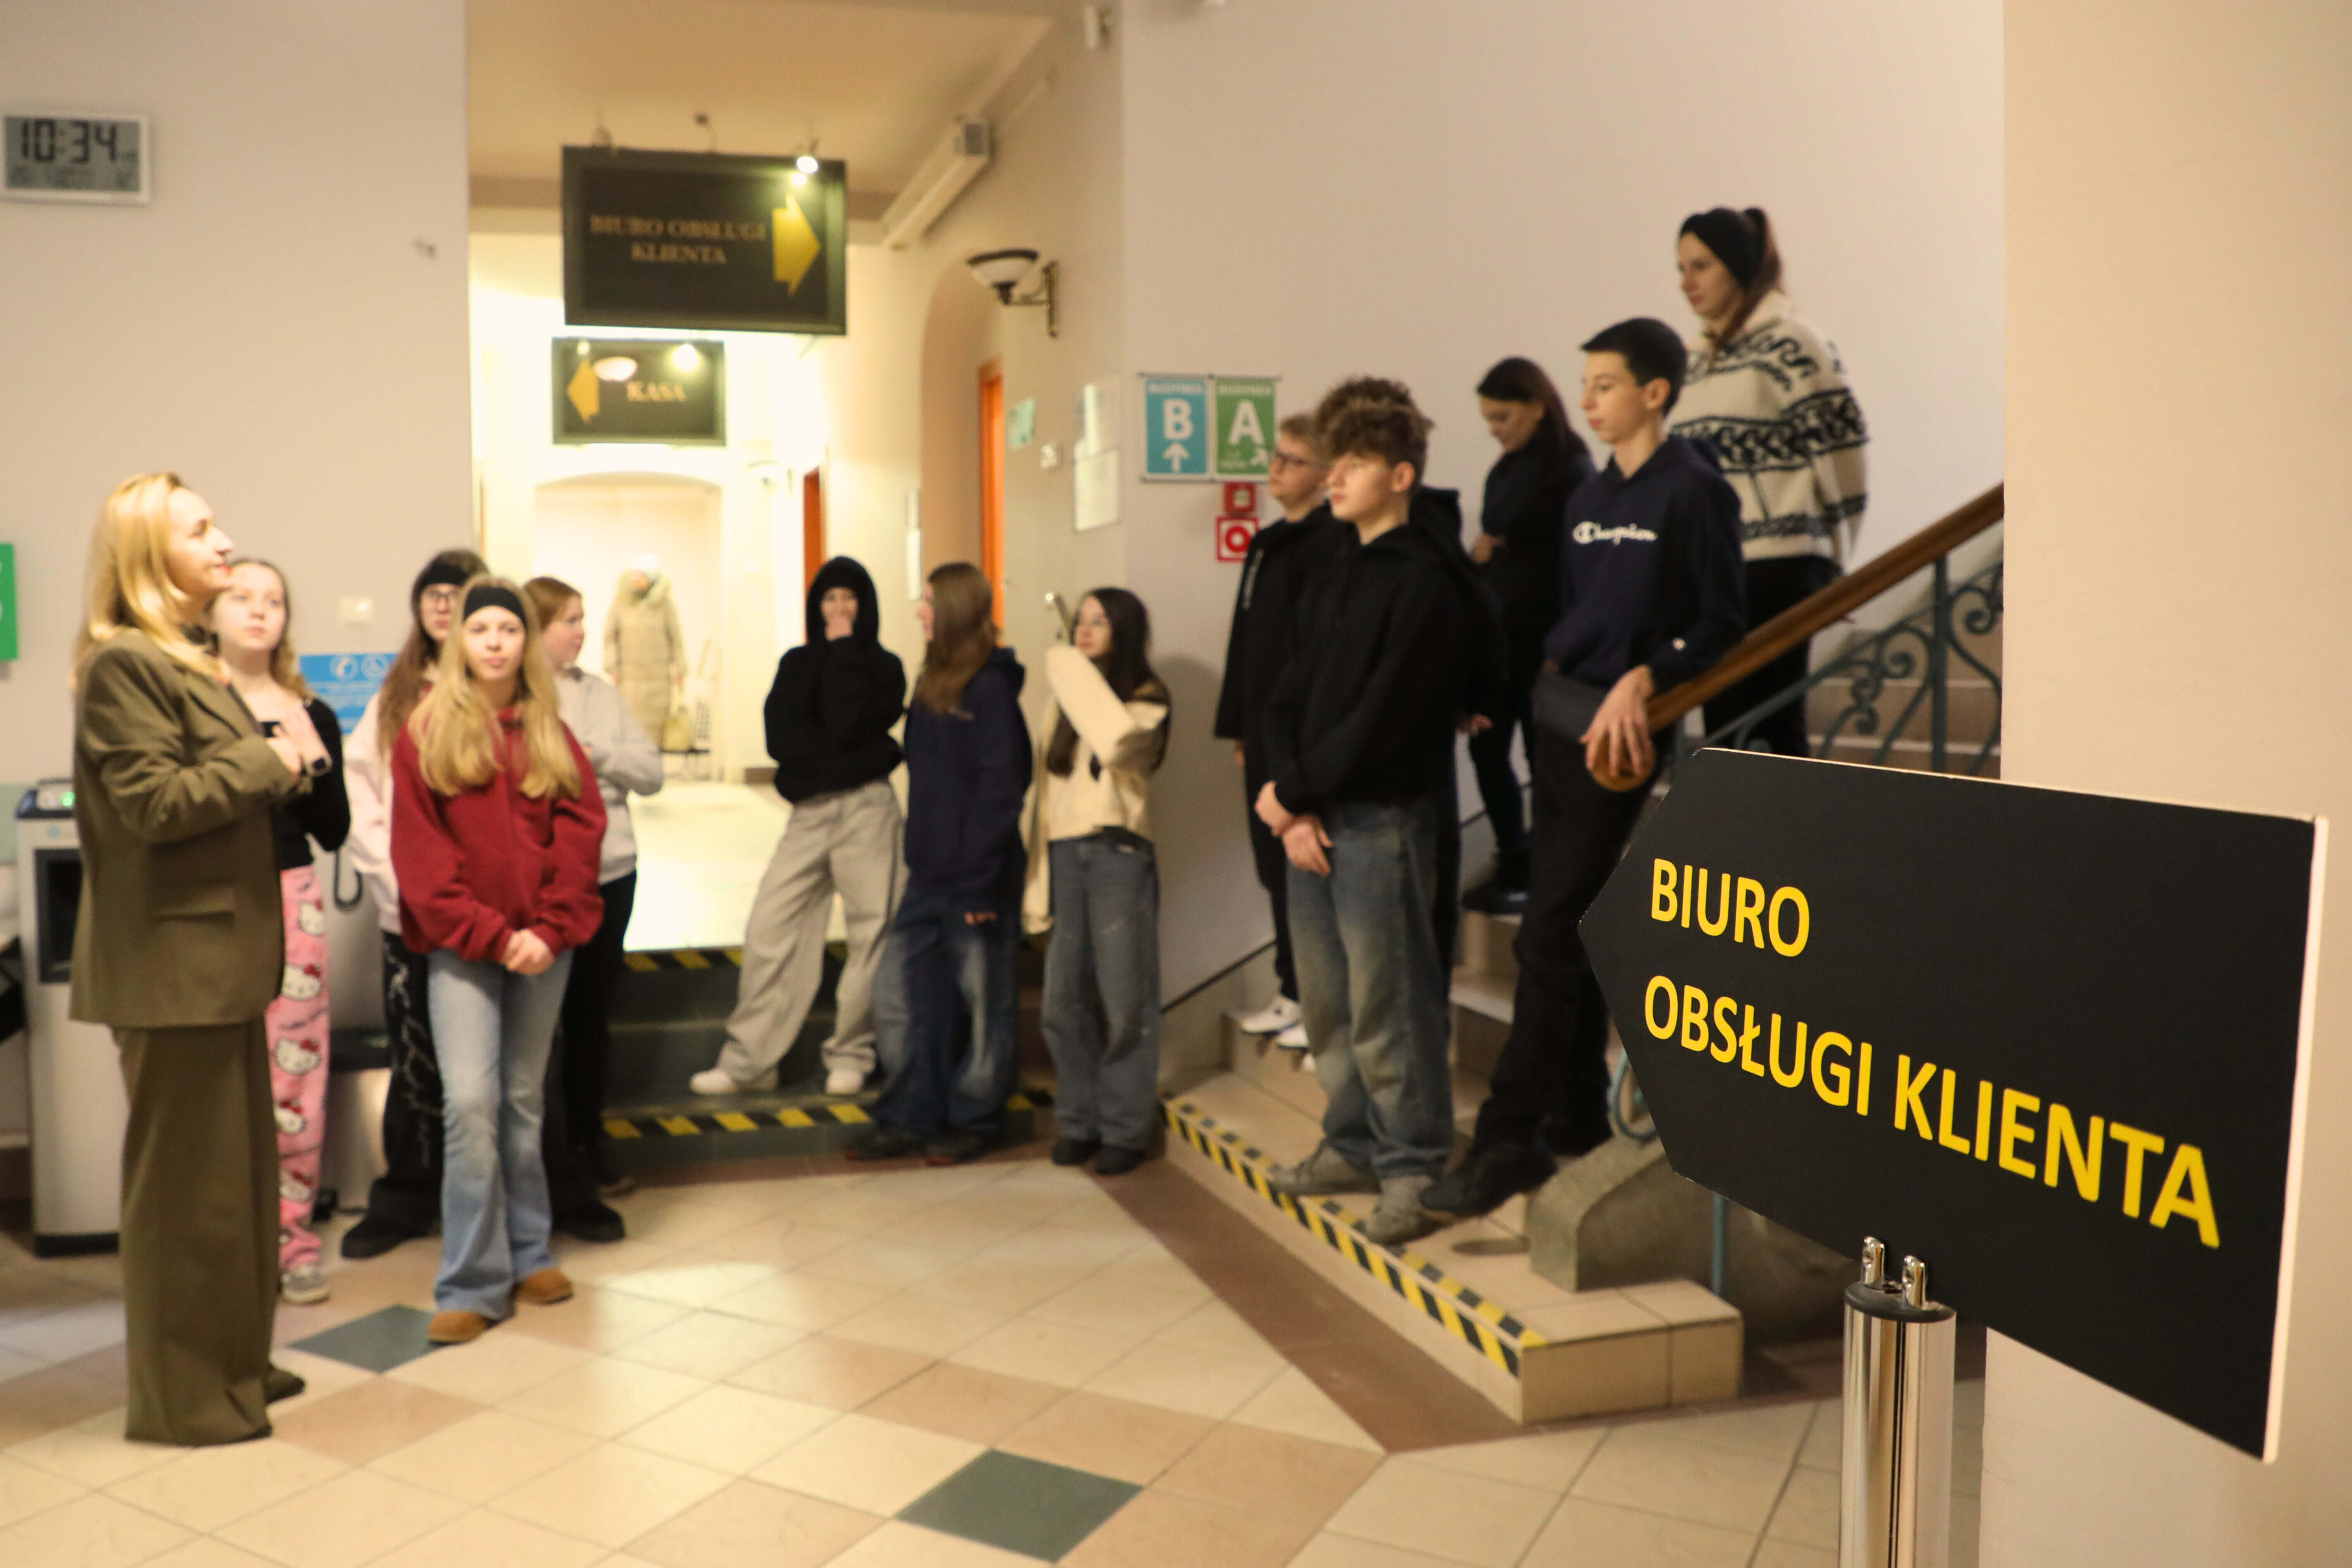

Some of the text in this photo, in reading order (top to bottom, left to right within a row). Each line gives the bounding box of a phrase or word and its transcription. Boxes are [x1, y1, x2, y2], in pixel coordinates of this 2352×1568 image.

[22, 118, 116, 163] 10:34
[591, 215, 663, 235] BIURO
[632, 243, 726, 264] KLIENTA
[627, 381, 686, 401] KASA
[1164, 398, 1193, 439] B
[1229, 400, 1264, 445] A
[1651, 858, 1810, 957] BIURO
[1645, 975, 2220, 1248] OBSŁUGI KLIENTA
